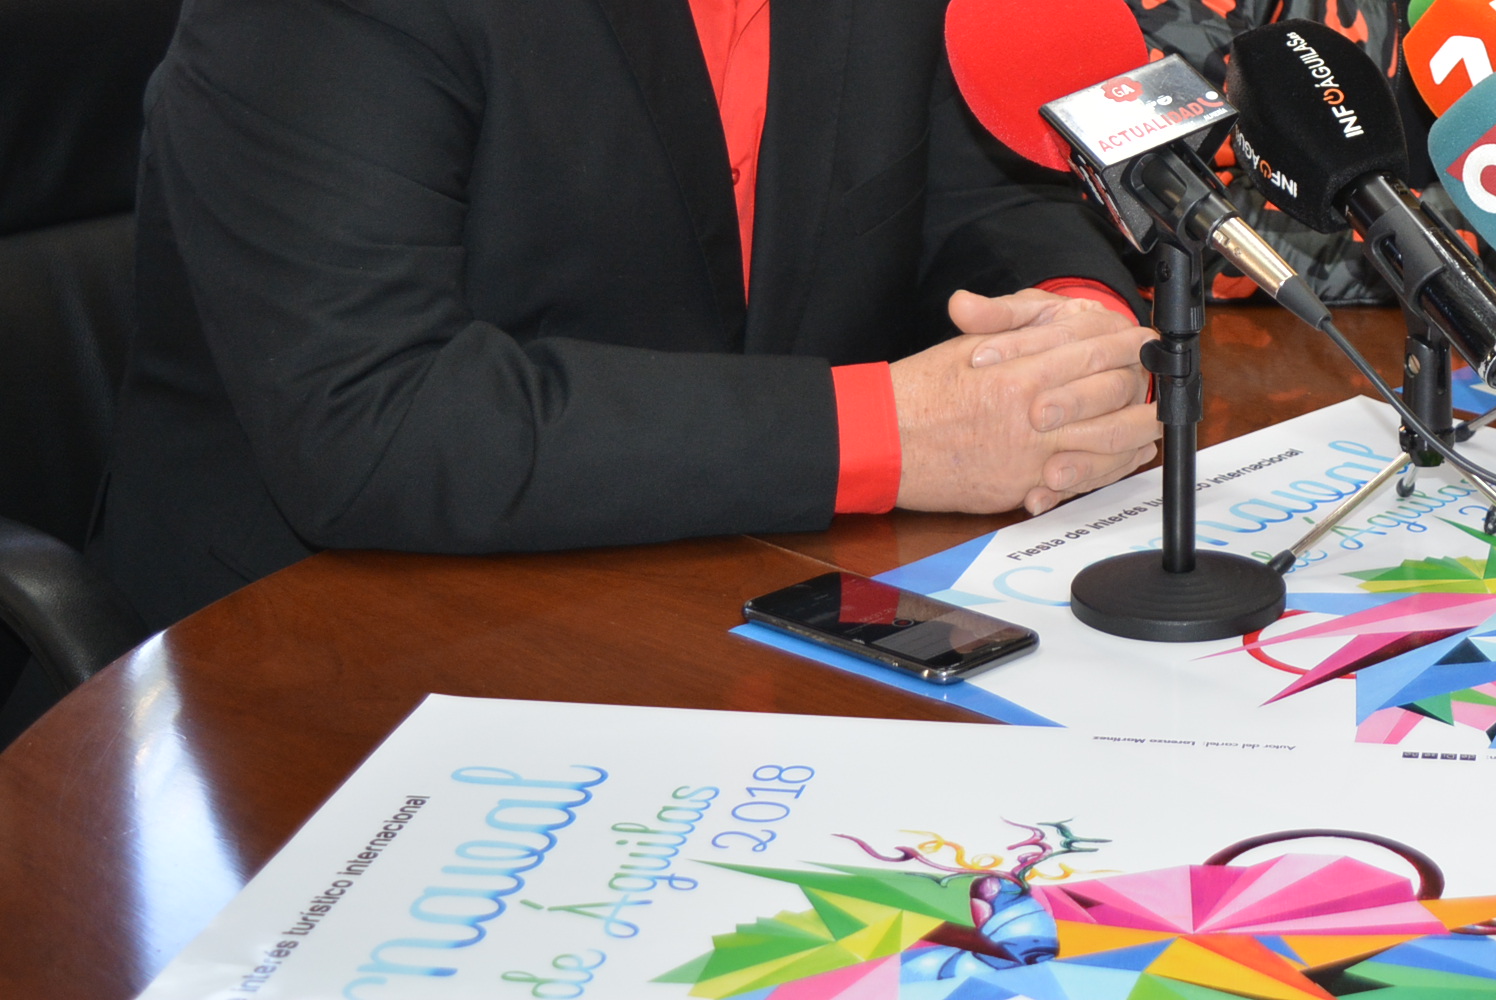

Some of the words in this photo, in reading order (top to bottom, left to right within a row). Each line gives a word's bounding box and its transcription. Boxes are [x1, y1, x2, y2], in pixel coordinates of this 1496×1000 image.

[1098, 100, 1205, 152] ACTUALIDAD
[1111, 83, 1136, 98] GA
[1007, 536, 1066, 561] Fiesta
[1065, 524, 1091, 541] de
[1092, 504, 1149, 531] interés
[1209, 447, 1305, 485] internacional
[711, 764, 815, 852] 2018
[240, 940, 299, 993] interés
[287, 879, 354, 936] turístico
[346, 795, 431, 876] internacional
[519, 785, 720, 938] Águilas
[500, 947, 608, 999] de
